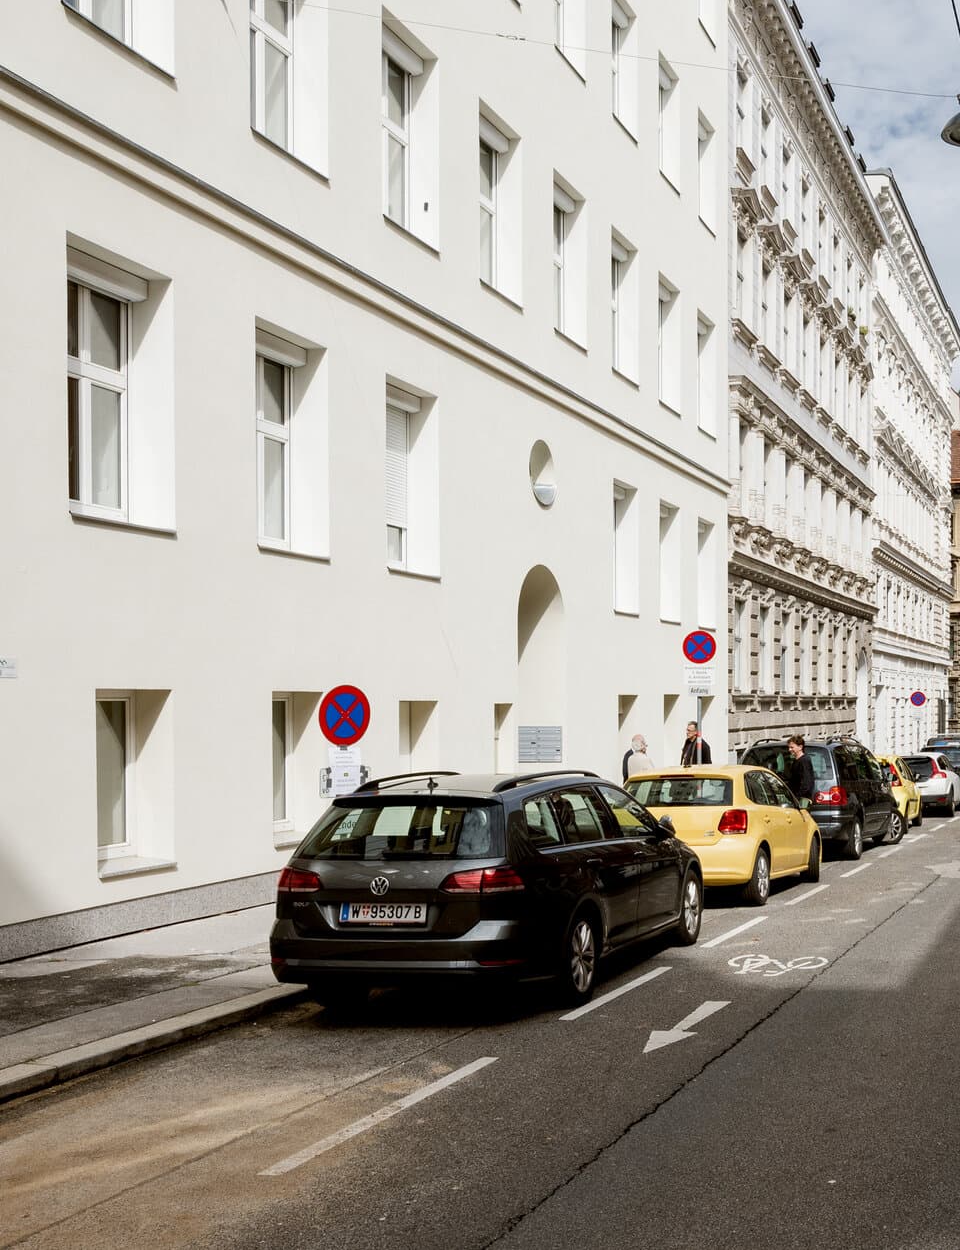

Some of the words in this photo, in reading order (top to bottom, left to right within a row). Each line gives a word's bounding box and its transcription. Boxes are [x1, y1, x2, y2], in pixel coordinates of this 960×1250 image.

[351, 904, 360, 919] W
[370, 905, 411, 919] 95307
[413, 905, 422, 919] B
